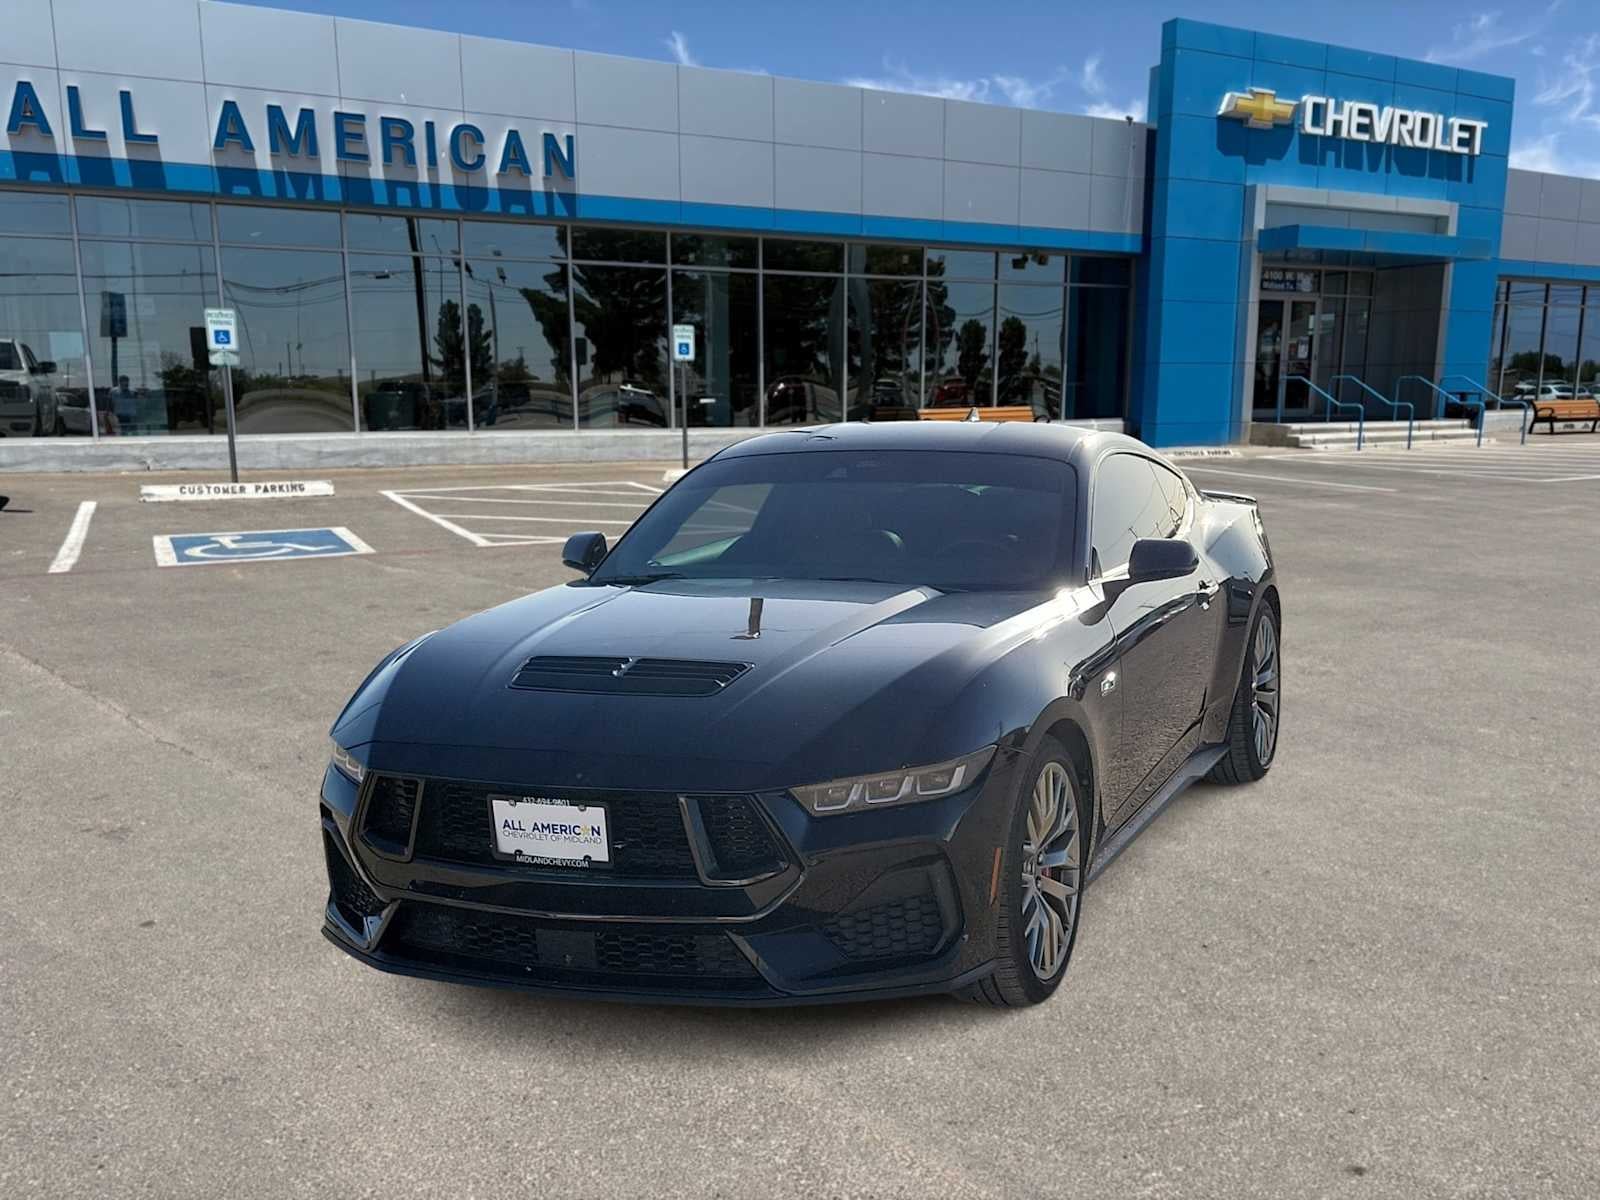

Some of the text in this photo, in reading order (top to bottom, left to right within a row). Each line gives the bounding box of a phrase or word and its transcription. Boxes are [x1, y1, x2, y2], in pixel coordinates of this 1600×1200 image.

[6, 80, 576, 179] ALL AMERICAN
[1301, 94, 1488, 156] CHEVROLET
[178, 483, 306, 496] CUSTOMER PARKING
[502, 819, 601, 836] ALL AMERICN
[502, 829, 602, 845] CHEVROLET OF MIDLAND
[516, 855, 589, 867] MIDLANDCHEVY.COM
